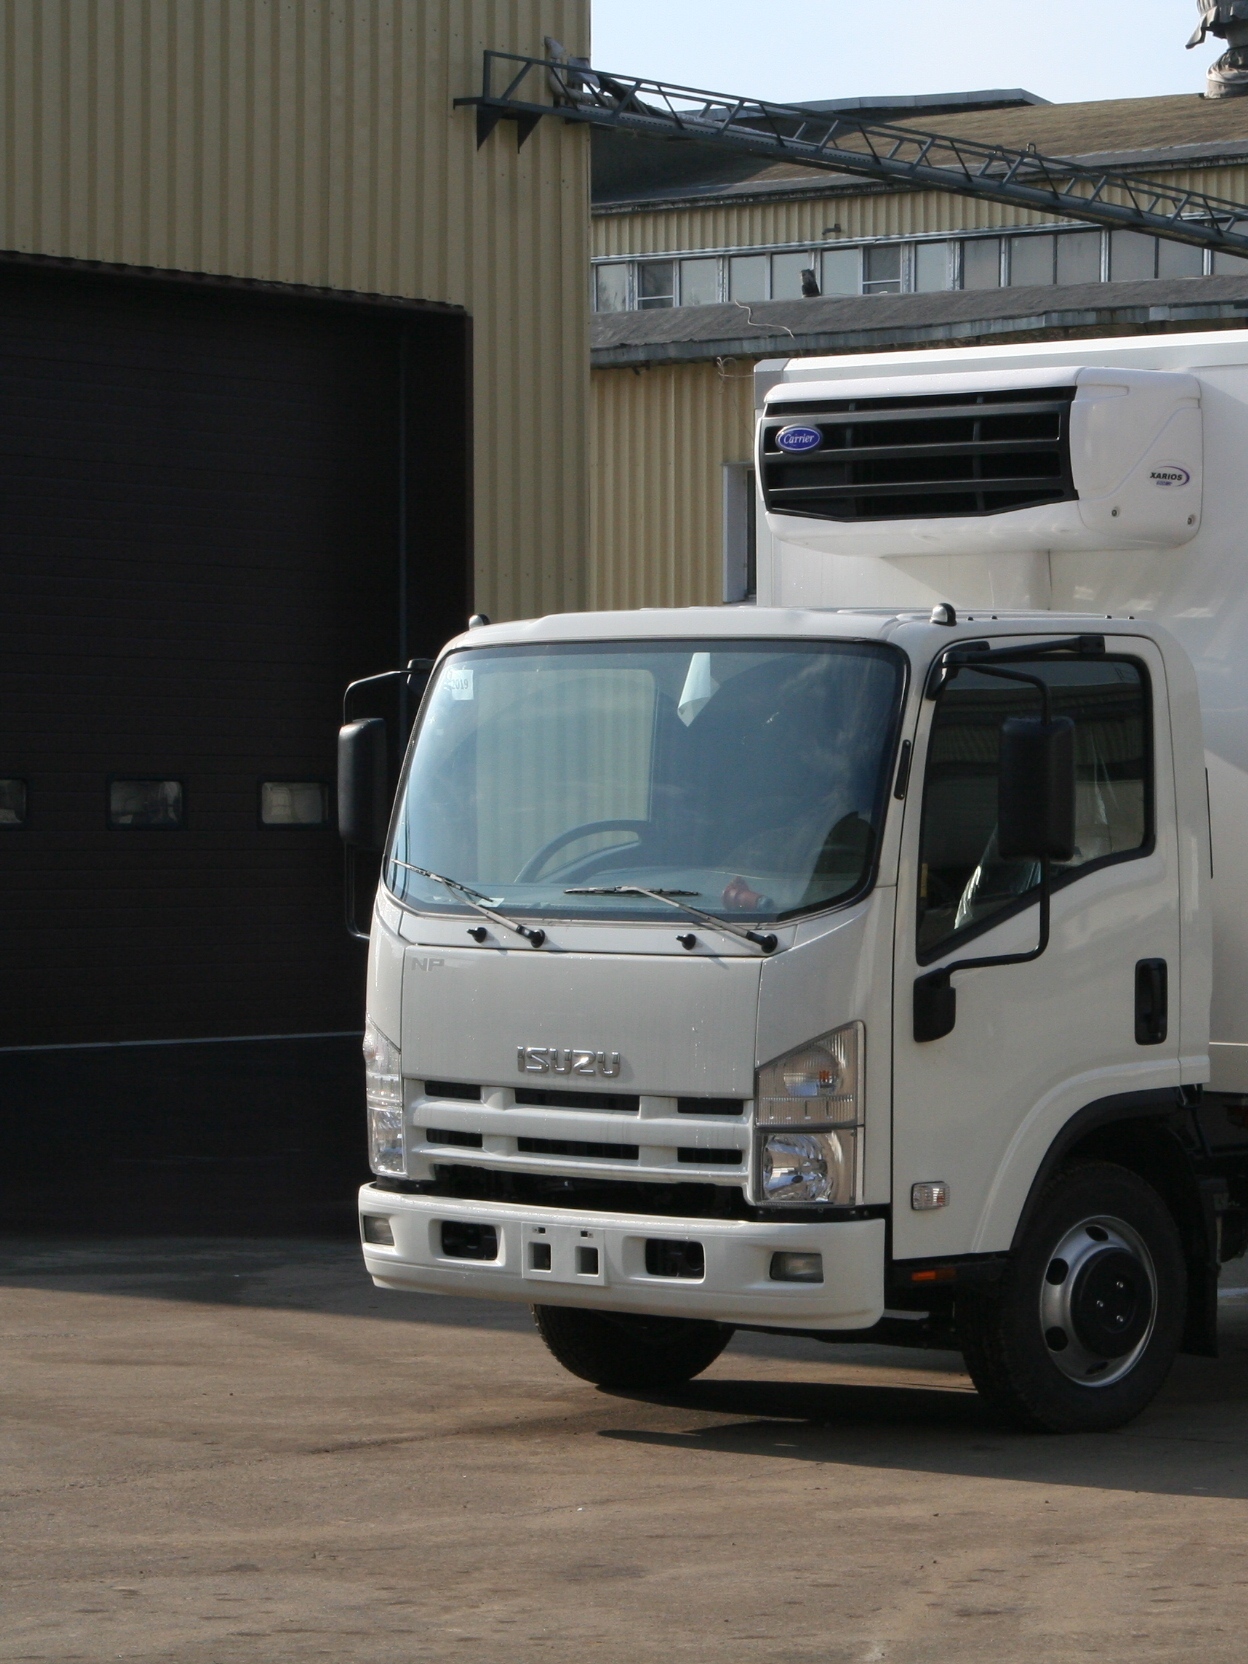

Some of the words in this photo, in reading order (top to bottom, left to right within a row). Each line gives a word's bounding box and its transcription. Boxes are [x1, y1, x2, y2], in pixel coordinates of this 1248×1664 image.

[783, 433, 814, 445] Carrier
[1150, 472, 1183, 481] XARIOS
[517, 1045, 621, 1078] ISUZU
